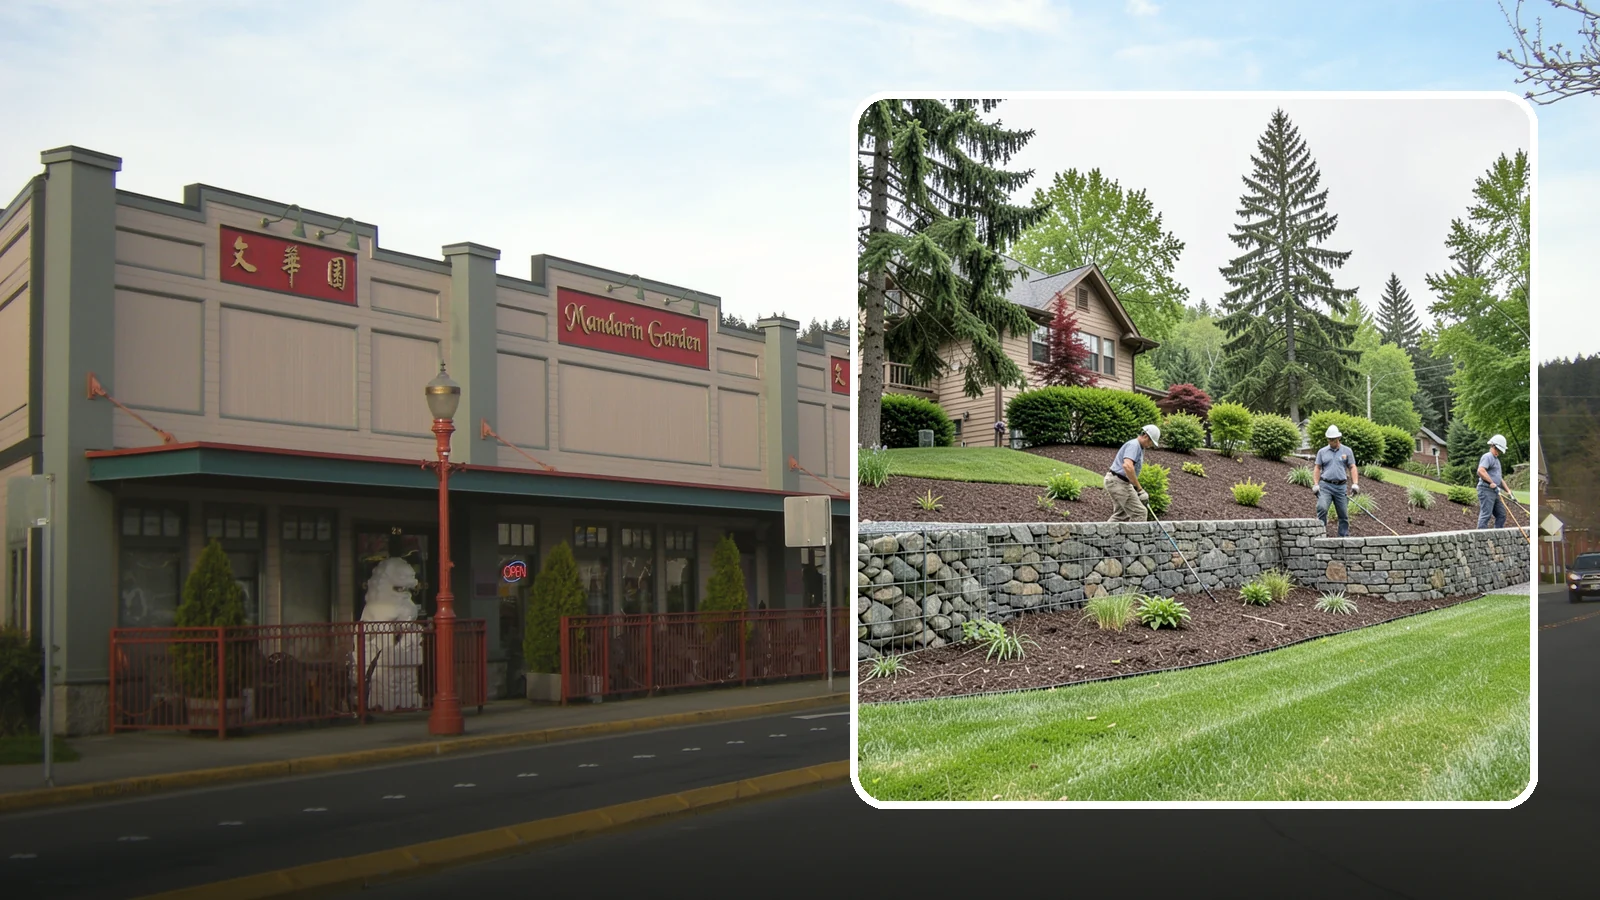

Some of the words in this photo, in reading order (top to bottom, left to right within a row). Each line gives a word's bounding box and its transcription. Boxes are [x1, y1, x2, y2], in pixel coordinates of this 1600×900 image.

[231, 236, 346, 291] 文華園
[564, 302, 644, 340] Mandarin
[648, 320, 702, 352] Garden
[503, 565, 527, 578] OPEN
